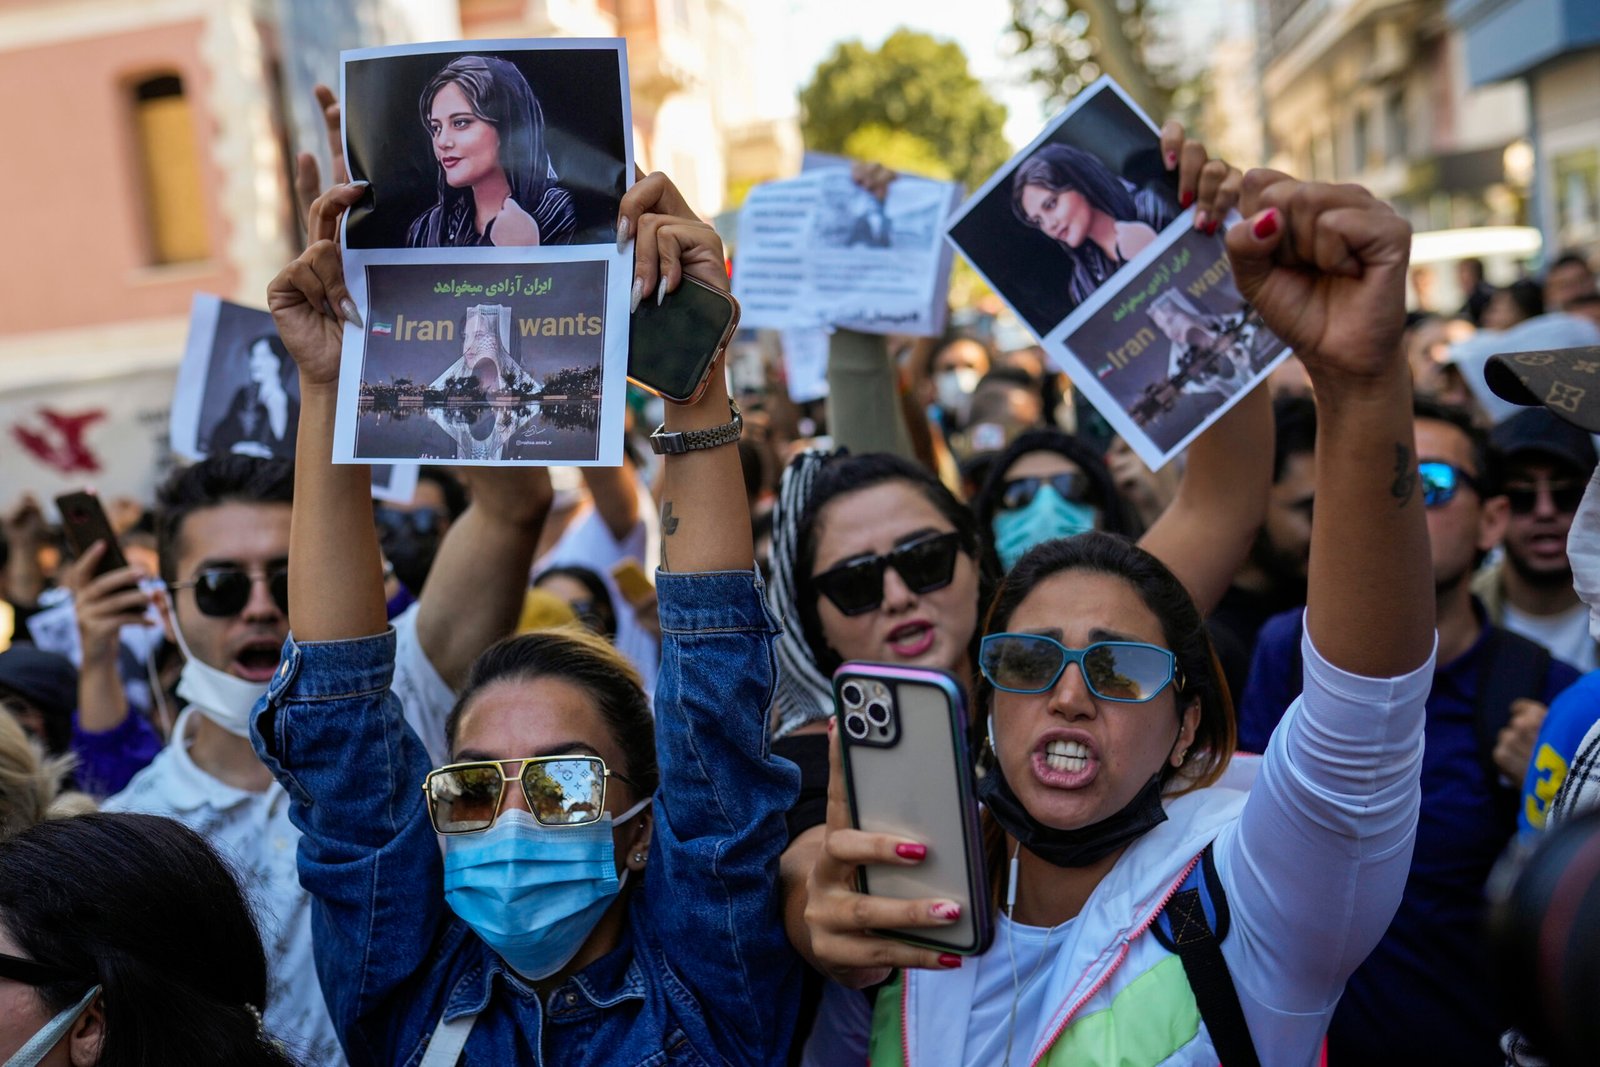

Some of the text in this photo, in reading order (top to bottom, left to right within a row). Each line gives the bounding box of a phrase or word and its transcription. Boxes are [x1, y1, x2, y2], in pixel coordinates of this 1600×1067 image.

[433, 275, 552, 297] ایران آزادی میخواهد
[395, 312, 602, 341] Iran wants
[1106, 327, 1156, 369] Iran
